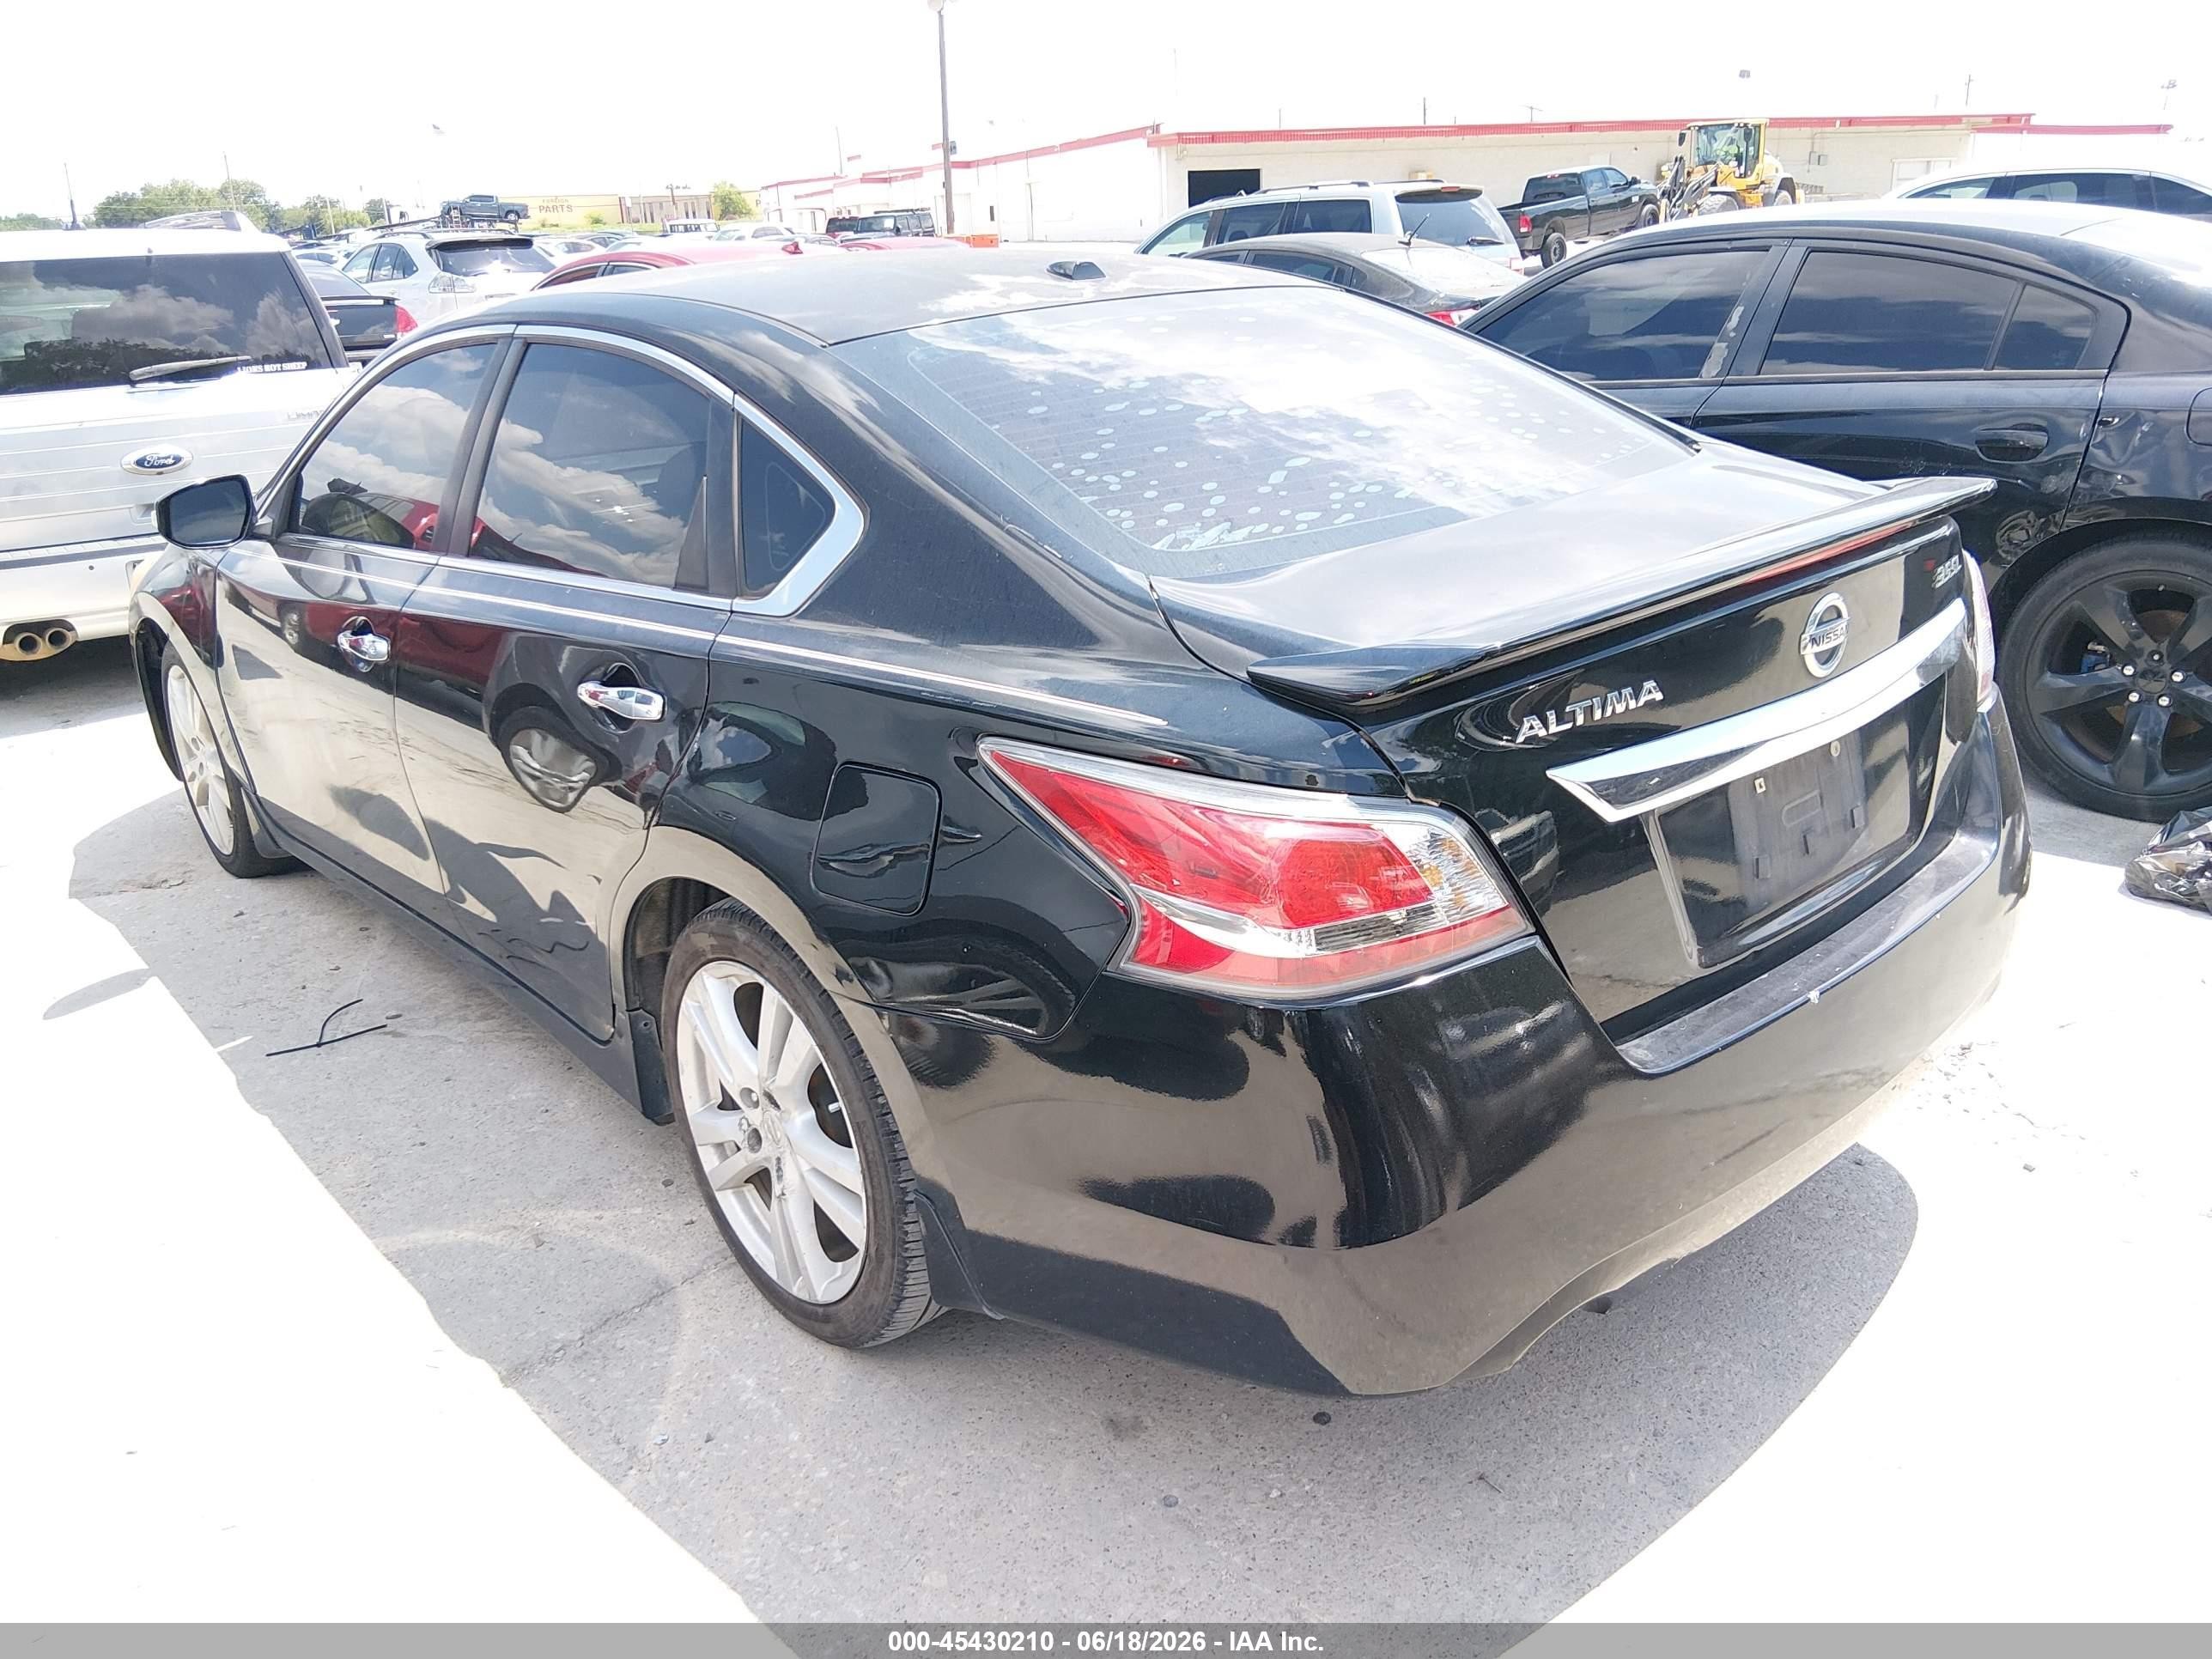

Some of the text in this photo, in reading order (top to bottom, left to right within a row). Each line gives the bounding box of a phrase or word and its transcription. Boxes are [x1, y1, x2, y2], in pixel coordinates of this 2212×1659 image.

[538, 204, 574, 213] PARTS
[282, 362, 307, 370] SHEEP
[144, 453, 175, 467] Ford
[1516, 679, 1664, 744] ALTIMA
